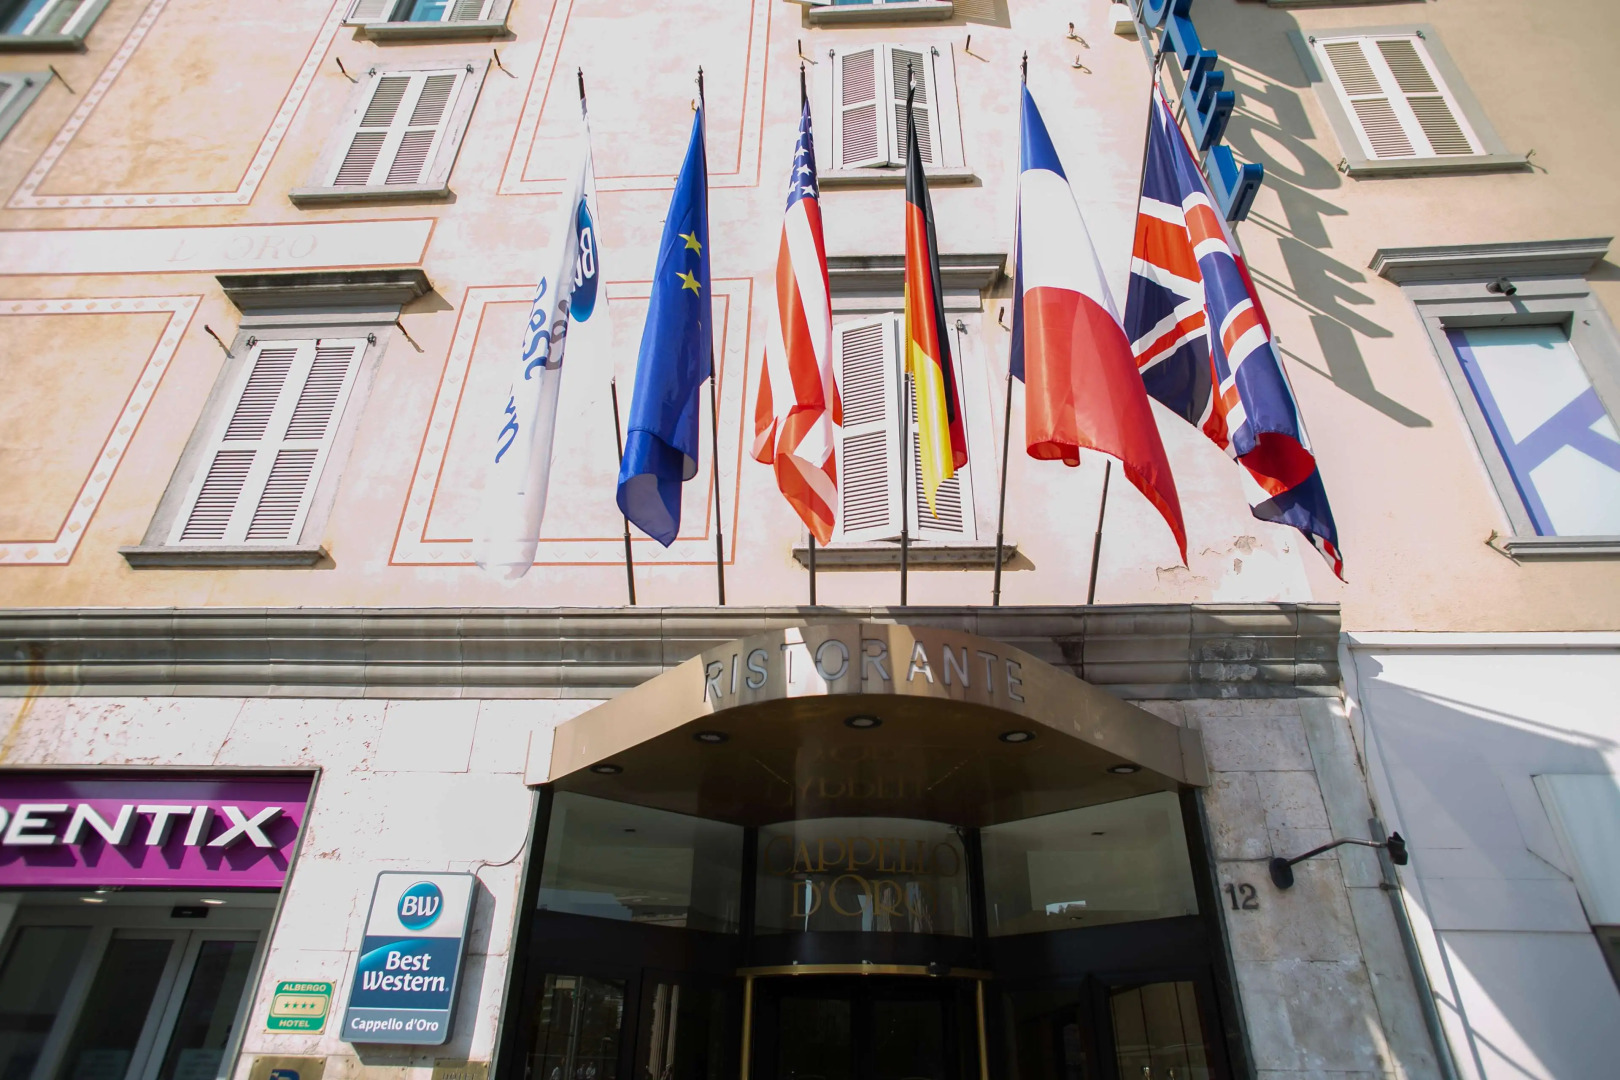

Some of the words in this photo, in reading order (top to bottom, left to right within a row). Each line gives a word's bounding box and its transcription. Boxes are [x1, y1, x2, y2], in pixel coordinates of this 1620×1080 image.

[703, 638, 1025, 703] RISTORANTE
[0, 803, 283, 848] ENTIX
[764, 835, 961, 877] CAPPELLO
[401, 895, 440, 916] BW
[791, 874, 938, 918] D'ORO
[1223, 882, 1260, 911] 12
[385, 950, 432, 972] Best
[282, 983, 327, 992] ALBERGO
[362, 970, 446, 992] Western
[278, 1019, 310, 1028] HOTEL
[351, 1017, 403, 1033] Cappello
[405, 1018, 439, 1032] d'Oro
